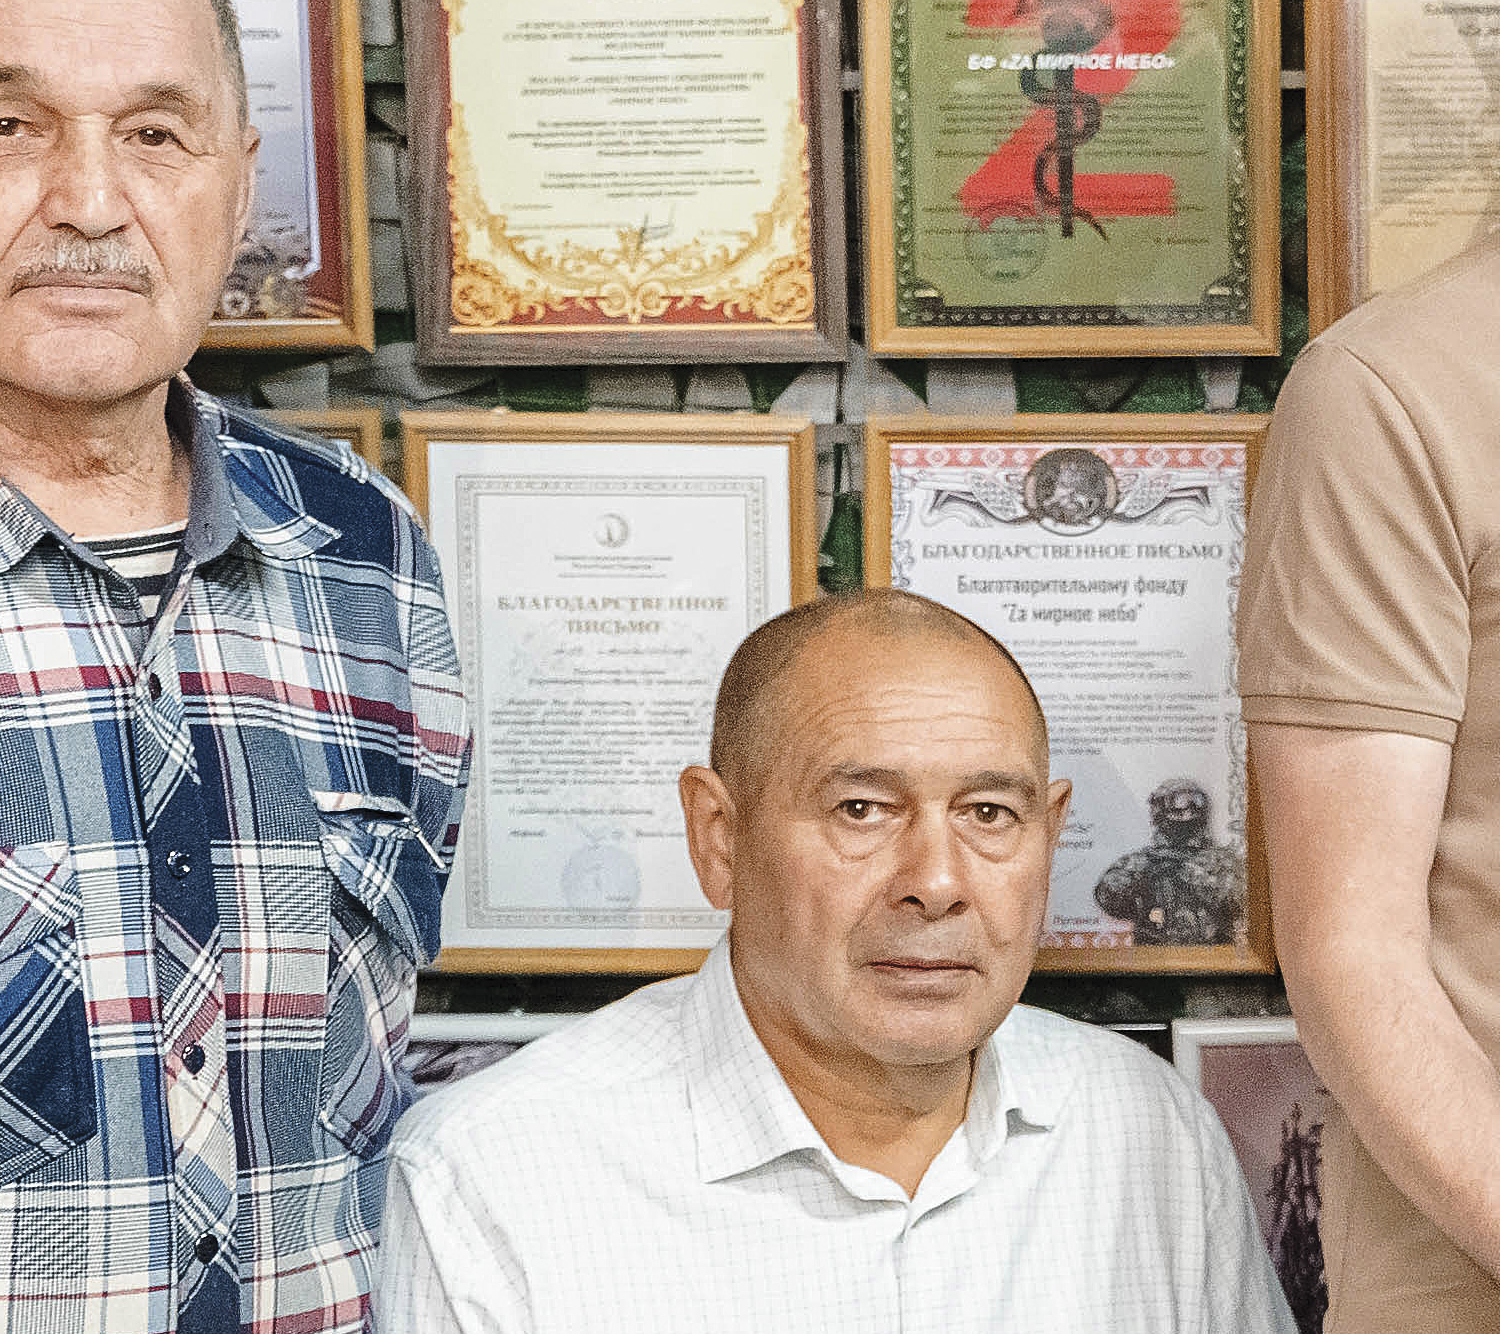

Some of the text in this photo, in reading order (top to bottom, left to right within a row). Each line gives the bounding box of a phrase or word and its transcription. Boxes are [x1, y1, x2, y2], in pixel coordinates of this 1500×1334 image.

[1034, 53, 1112, 71] МИРНОЕ
[1116, 53, 1176, 71] НЕБО»
[922, 544, 1224, 561] БЛАГОДАРСТВЕННОЕ ПИСЬМО
[957, 575, 1189, 598] Благотворительному фонду
[497, 595, 729, 613] БЛАГОДАРСТВЕННОЕ
[1033, 605, 1095, 625] мирное
[566, 620, 663, 636] ПИСЬМО
